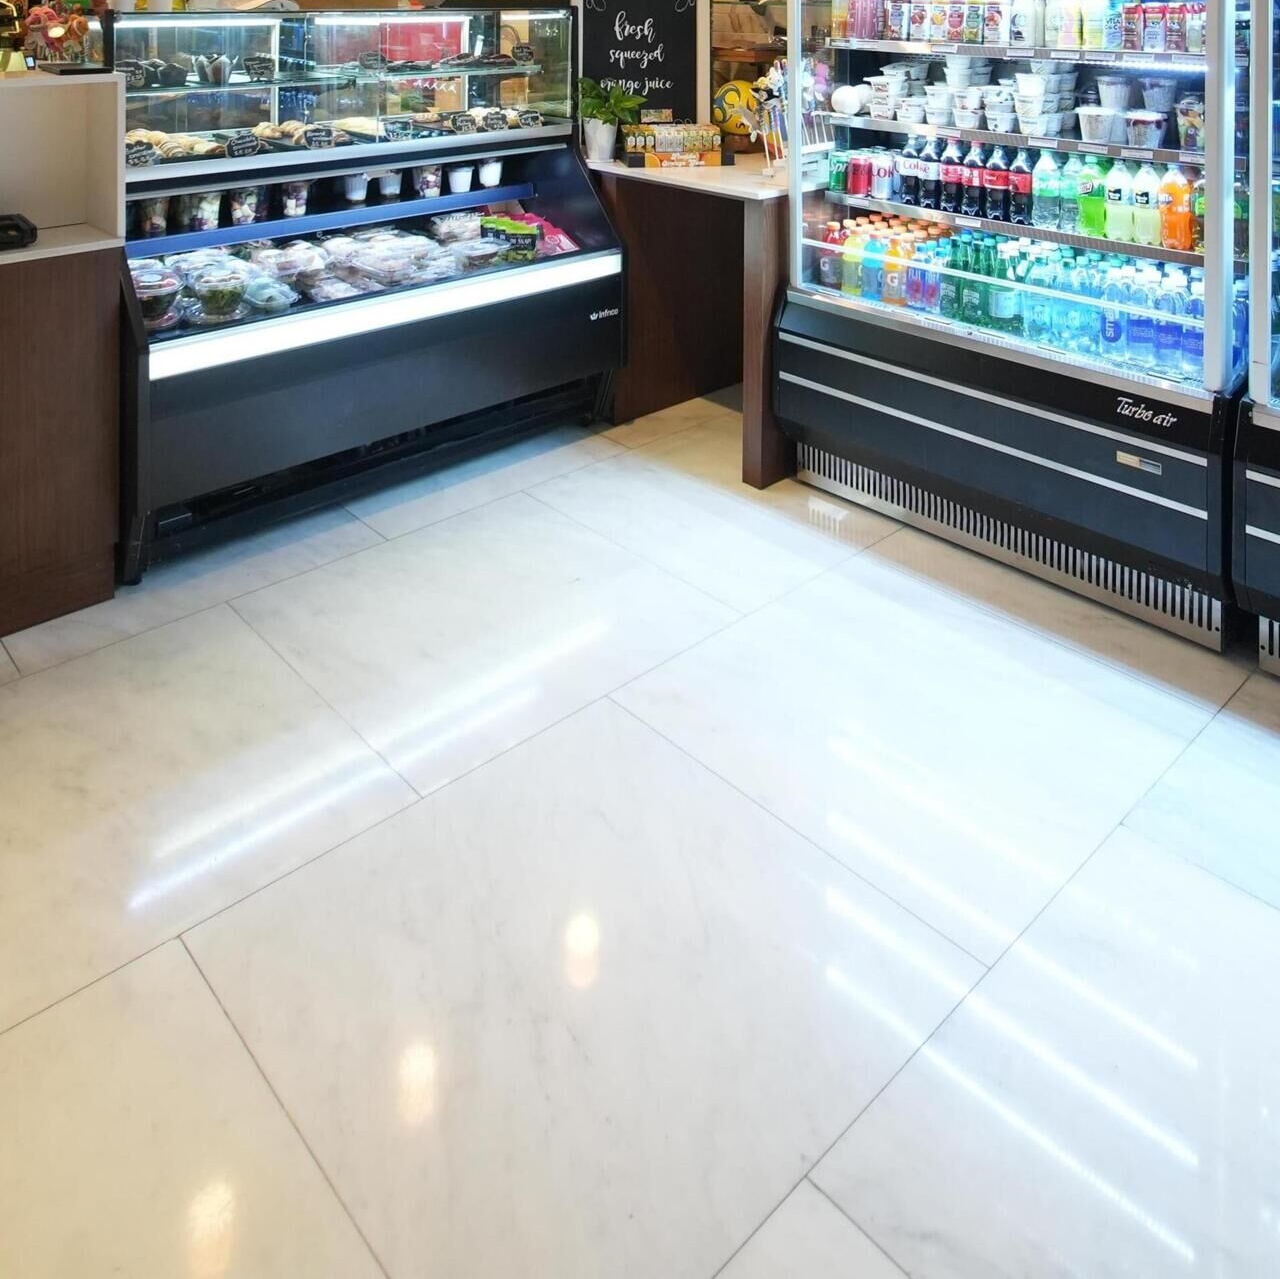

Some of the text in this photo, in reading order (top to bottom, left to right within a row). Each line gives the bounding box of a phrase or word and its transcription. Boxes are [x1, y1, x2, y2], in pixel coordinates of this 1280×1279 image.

[614, 10, 655, 43] fresh
[609, 43, 665, 69] squeezed
[643, 77, 674, 96] juice
[887, 272, 899, 287] G
[1116, 396, 1178, 427] Turbo air
